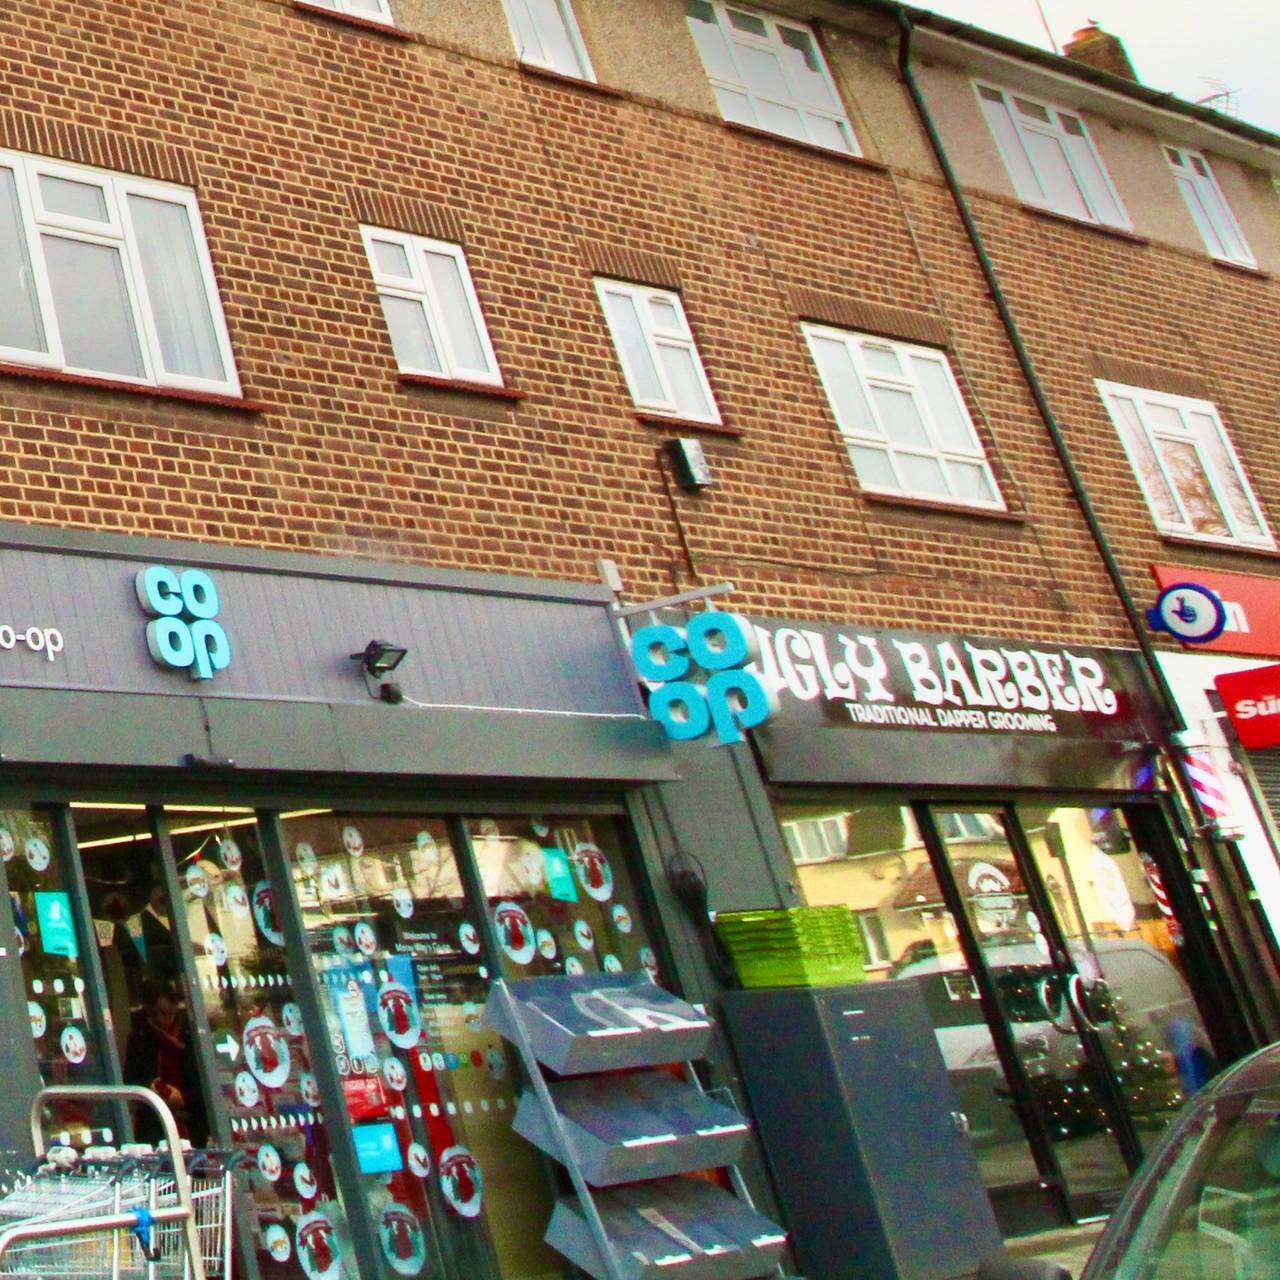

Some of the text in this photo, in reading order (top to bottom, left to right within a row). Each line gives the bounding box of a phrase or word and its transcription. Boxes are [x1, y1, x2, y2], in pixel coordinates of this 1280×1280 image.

[892, 638, 1118, 715] BARBER
[845, 702, 1057, 732] TRADITIONAL DAPPER GROOMING
